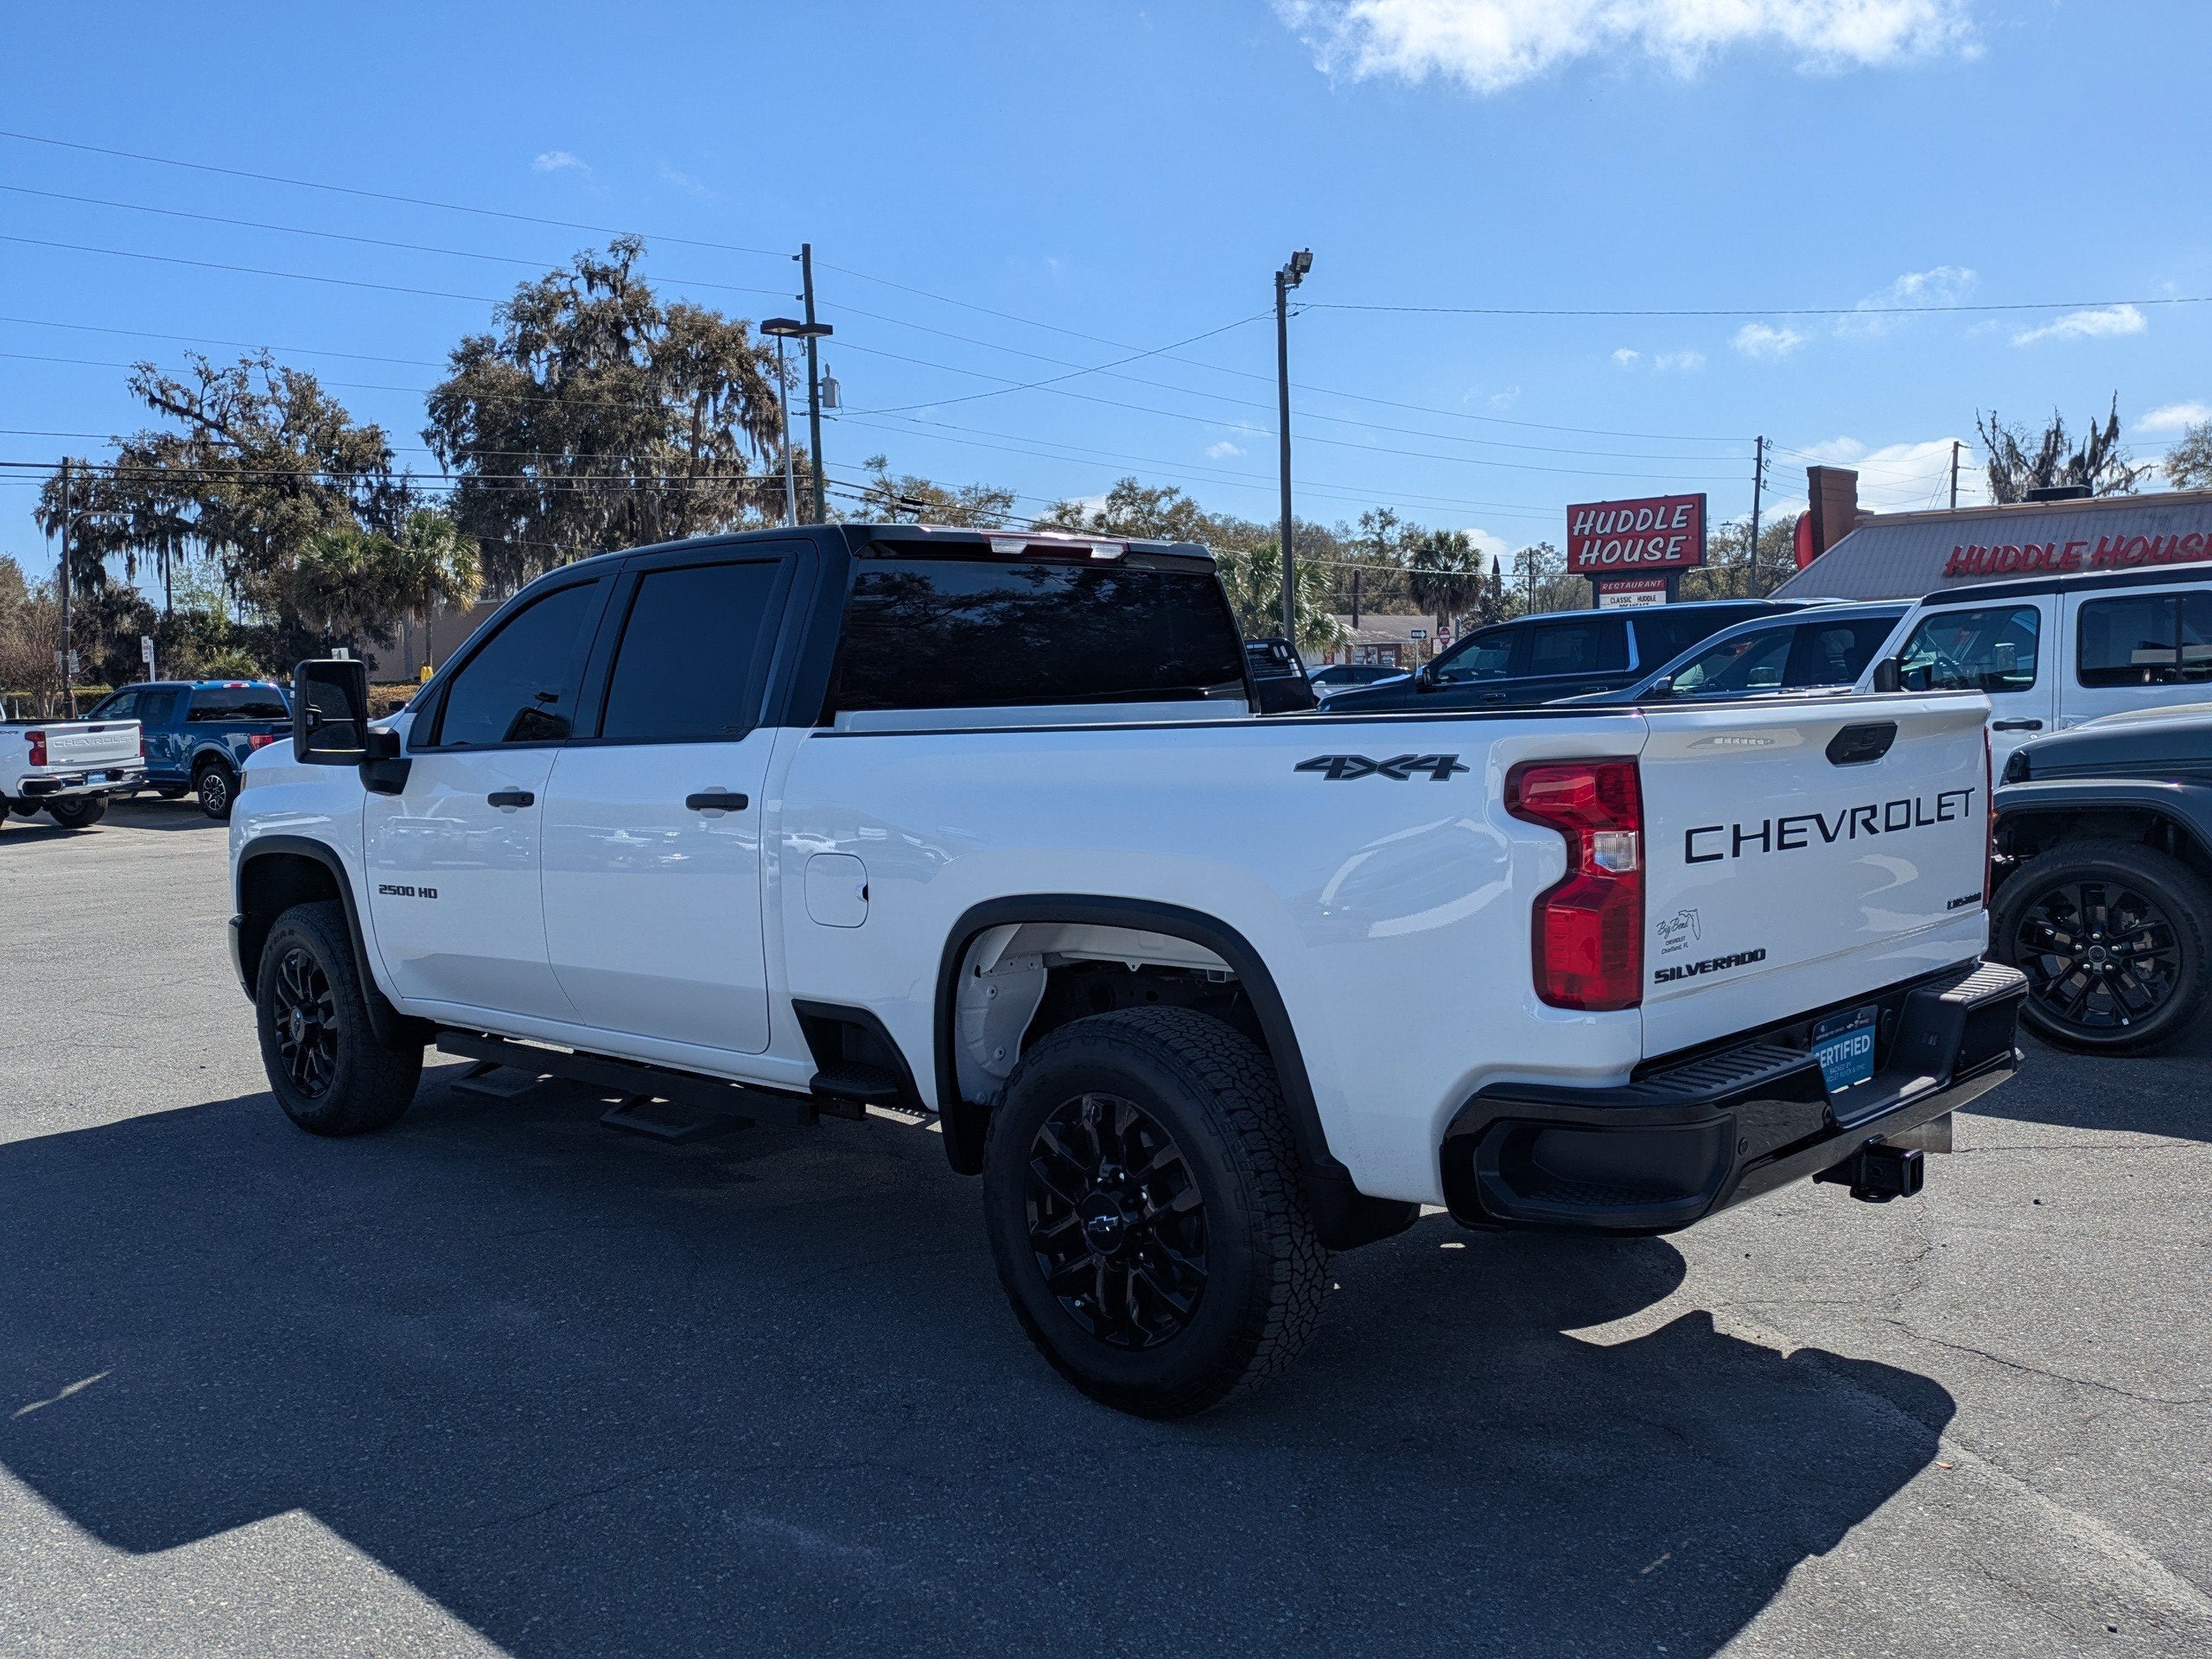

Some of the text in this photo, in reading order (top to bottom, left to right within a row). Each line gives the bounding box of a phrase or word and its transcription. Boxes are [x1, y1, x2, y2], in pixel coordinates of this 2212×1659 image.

[1573, 504, 1694, 537] HUDDLE
[1579, 536, 1687, 566] HOUSE
[1945, 540, 2088, 576] HUDDLE
[1601, 580, 1662, 590] RESTAURANT
[54, 735, 134, 747] CHEVROLET
[1685, 786, 1976, 864] CHEVROLET
[378, 884, 438, 899] 2500 HD
[1656, 920, 1670, 939] Big
[1654, 947, 1766, 984] SILVERADO
